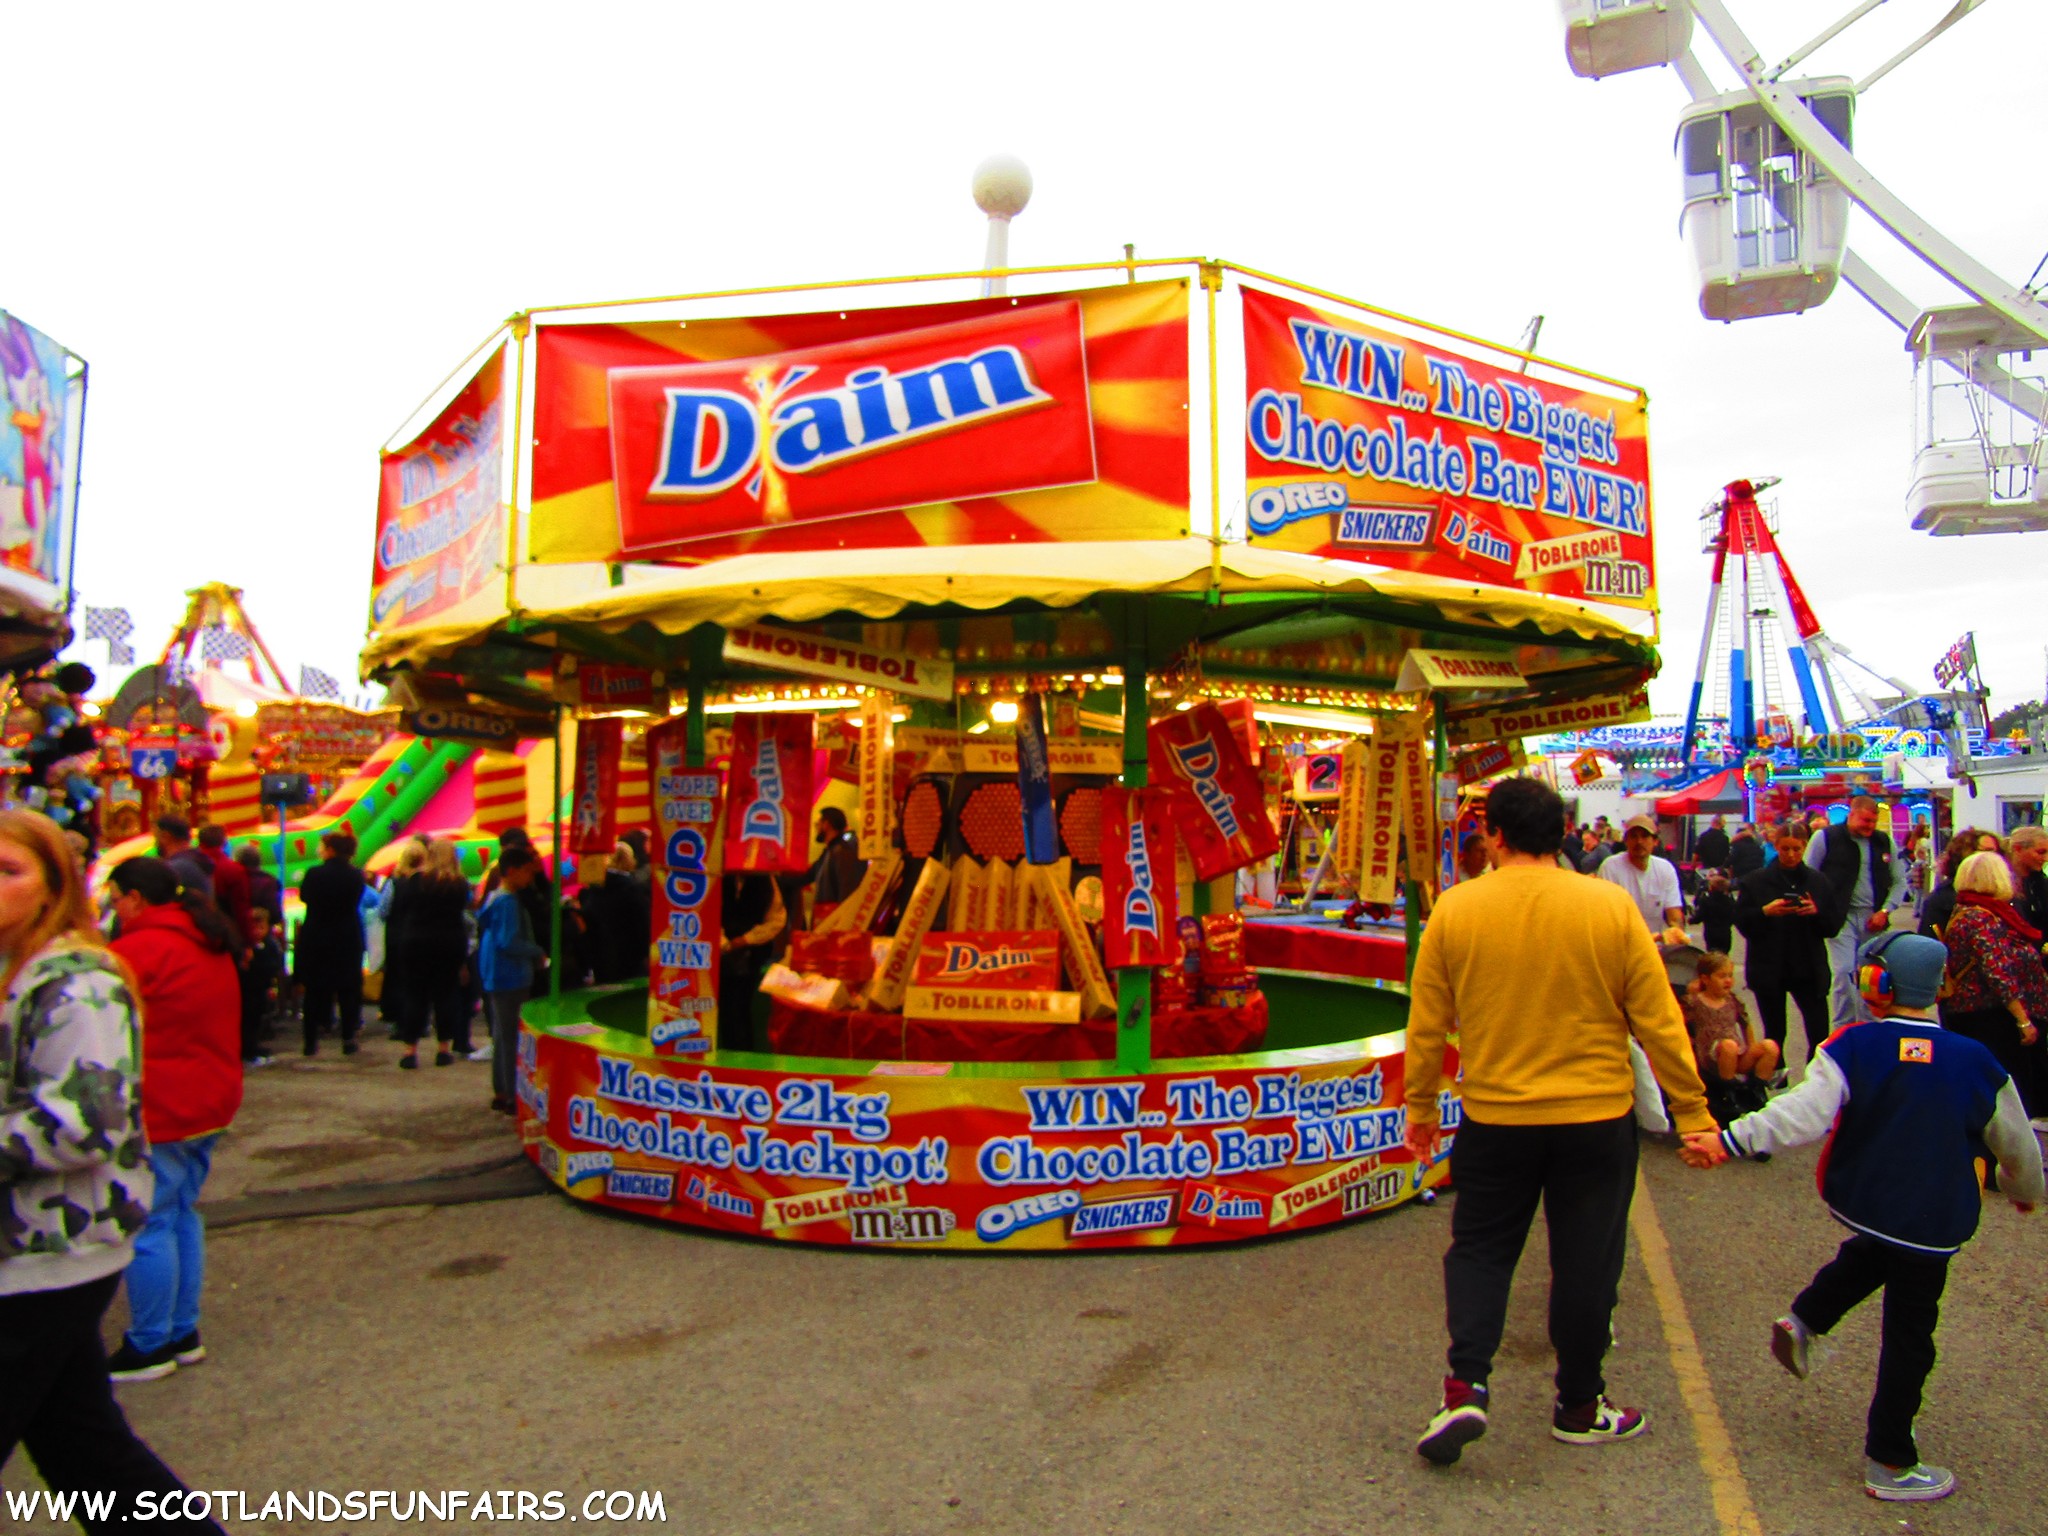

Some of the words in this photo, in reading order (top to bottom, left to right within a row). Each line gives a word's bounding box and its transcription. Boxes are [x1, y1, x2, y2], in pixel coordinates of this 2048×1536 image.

[1427, 356, 1502, 430] The
[1498, 378, 1617, 465] Biggest
[1248, 387, 1466, 496] Chocolate
[1469, 437, 1540, 509] Bar
[1542, 459, 1647, 537] EVER!
[1248, 483, 1347, 527] OREO
[1341, 509, 1431, 543] SNICKERS
[1529, 535, 1618, 571] TOBLERONE
[733, 628, 919, 685] TOBLERONE
[1431, 655, 1518, 680] TOBLERONE
[1491, 702, 1620, 736] TOBLERONE
[989, 750, 1096, 767] TORONE
[1796, 733, 1865, 760] KID
[1857, 727, 1985, 760] ZONE
[659, 776, 718, 798] SCORE
[741, 737, 785, 848] Daim
[863, 713, 877, 840] TOBLERONE
[1170, 732, 1240, 840] Daim
[1310, 757, 1338, 791] 2
[663, 801, 714, 824] OVER
[1371, 741, 1400, 877] TOBLERONE
[1405, 740, 1427, 853] TOBLERONE
[1124, 820, 1158, 940] Daim
[669, 911, 700, 939] TO
[937, 941, 1034, 977] Daim
[932, 992, 1051, 1012] TOBLERONE
[598, 1056, 771, 1122] Massive
[776, 1079, 890, 1142] 2kg
[1168, 1077, 1252, 1125] The
[1254, 1063, 1383, 1120] Biggest
[567, 1096, 732, 1168] Chocolate
[734, 1125, 948, 1192] Jackpot!
[977, 1131, 1211, 1187] Chocolate
[1213, 1127, 1294, 1174] Bar
[611, 1171, 673, 1199] SNICKERS
[774, 1185, 902, 1221] TOBLERONE
[1281, 1157, 1379, 1217] TOBLERONE
[976, 1190, 1081, 1235] OREO
[1076, 1198, 1169, 1231] SNICKERS
